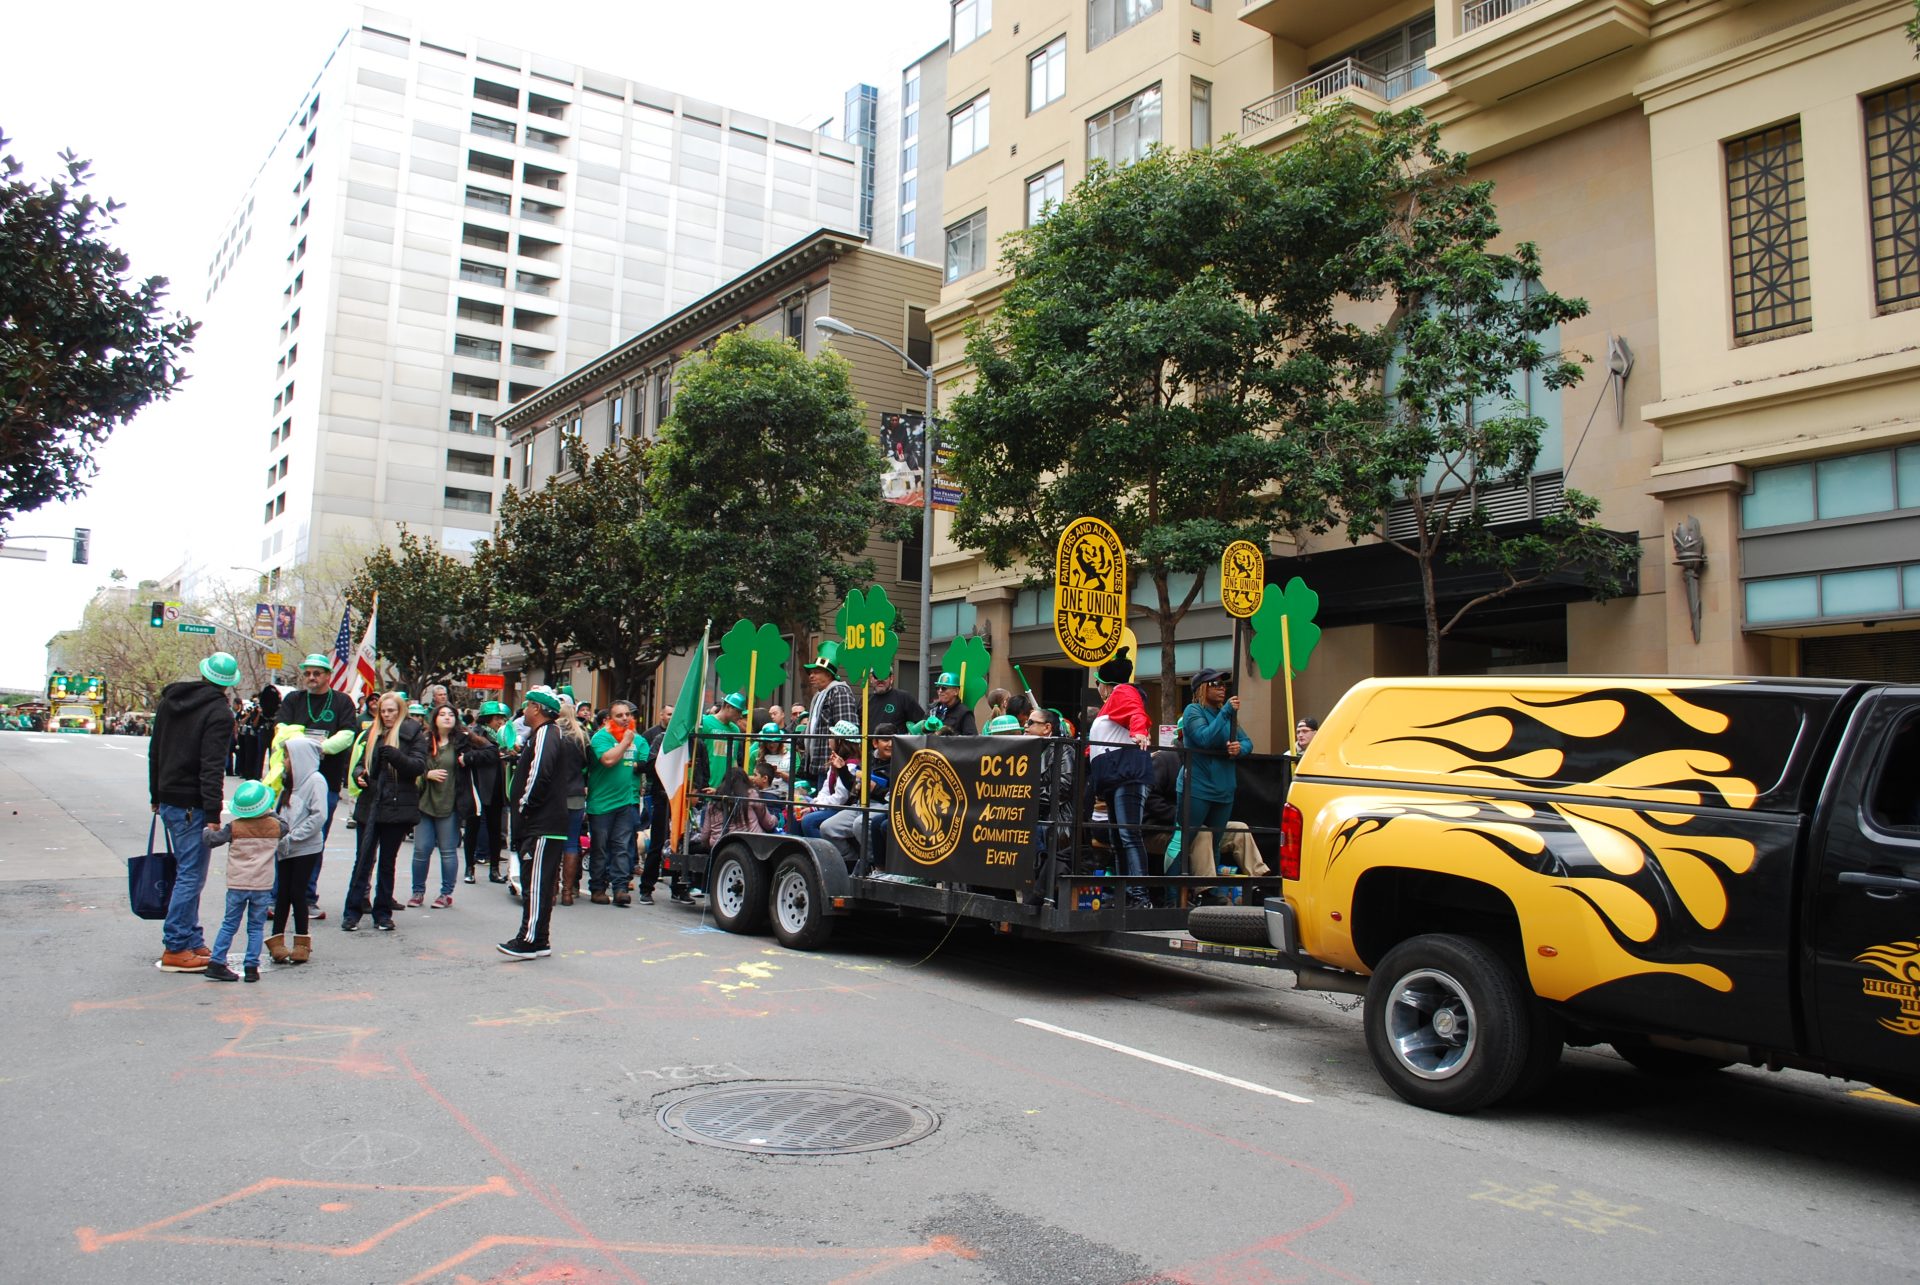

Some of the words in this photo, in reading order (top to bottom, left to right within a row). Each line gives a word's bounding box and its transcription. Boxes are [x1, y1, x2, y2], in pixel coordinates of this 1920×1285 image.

[1061, 533, 1076, 583] PAINTERS
[1075, 522, 1092, 537] AND
[1093, 524, 1118, 551] ALLIED
[1114, 552, 1122, 592] TRADES
[1225, 577, 1237, 588] ONE
[1240, 579, 1260, 591] UNION
[1062, 588, 1083, 611] ONE
[1088, 592, 1120, 616] UNION
[847, 624, 865, 649] DC
[870, 621, 885, 648] 16
[1059, 614, 1107, 660] INTERNATIONAL
[1106, 620, 1120, 652] UNION
[981, 755, 1002, 776] DC
[1006, 755, 1028, 776] 16
[897, 758, 920, 796] VOLUNTEER
[918, 754, 938, 764] ACTIVIST
[938, 760, 964, 800] COMMITTEE
[976, 782, 1032, 800] VOLUNTEER
[979, 803, 1025, 822] ACTIVIST
[895, 811, 904, 832] HIGH
[949, 816, 960, 842] VALUE
[911, 827, 926, 846] DC
[929, 830, 946, 846] 16
[972, 824, 1030, 844] COMMITTEE
[986, 848, 1018, 866] EVENT
[1865, 980, 1911, 996] HIGH
